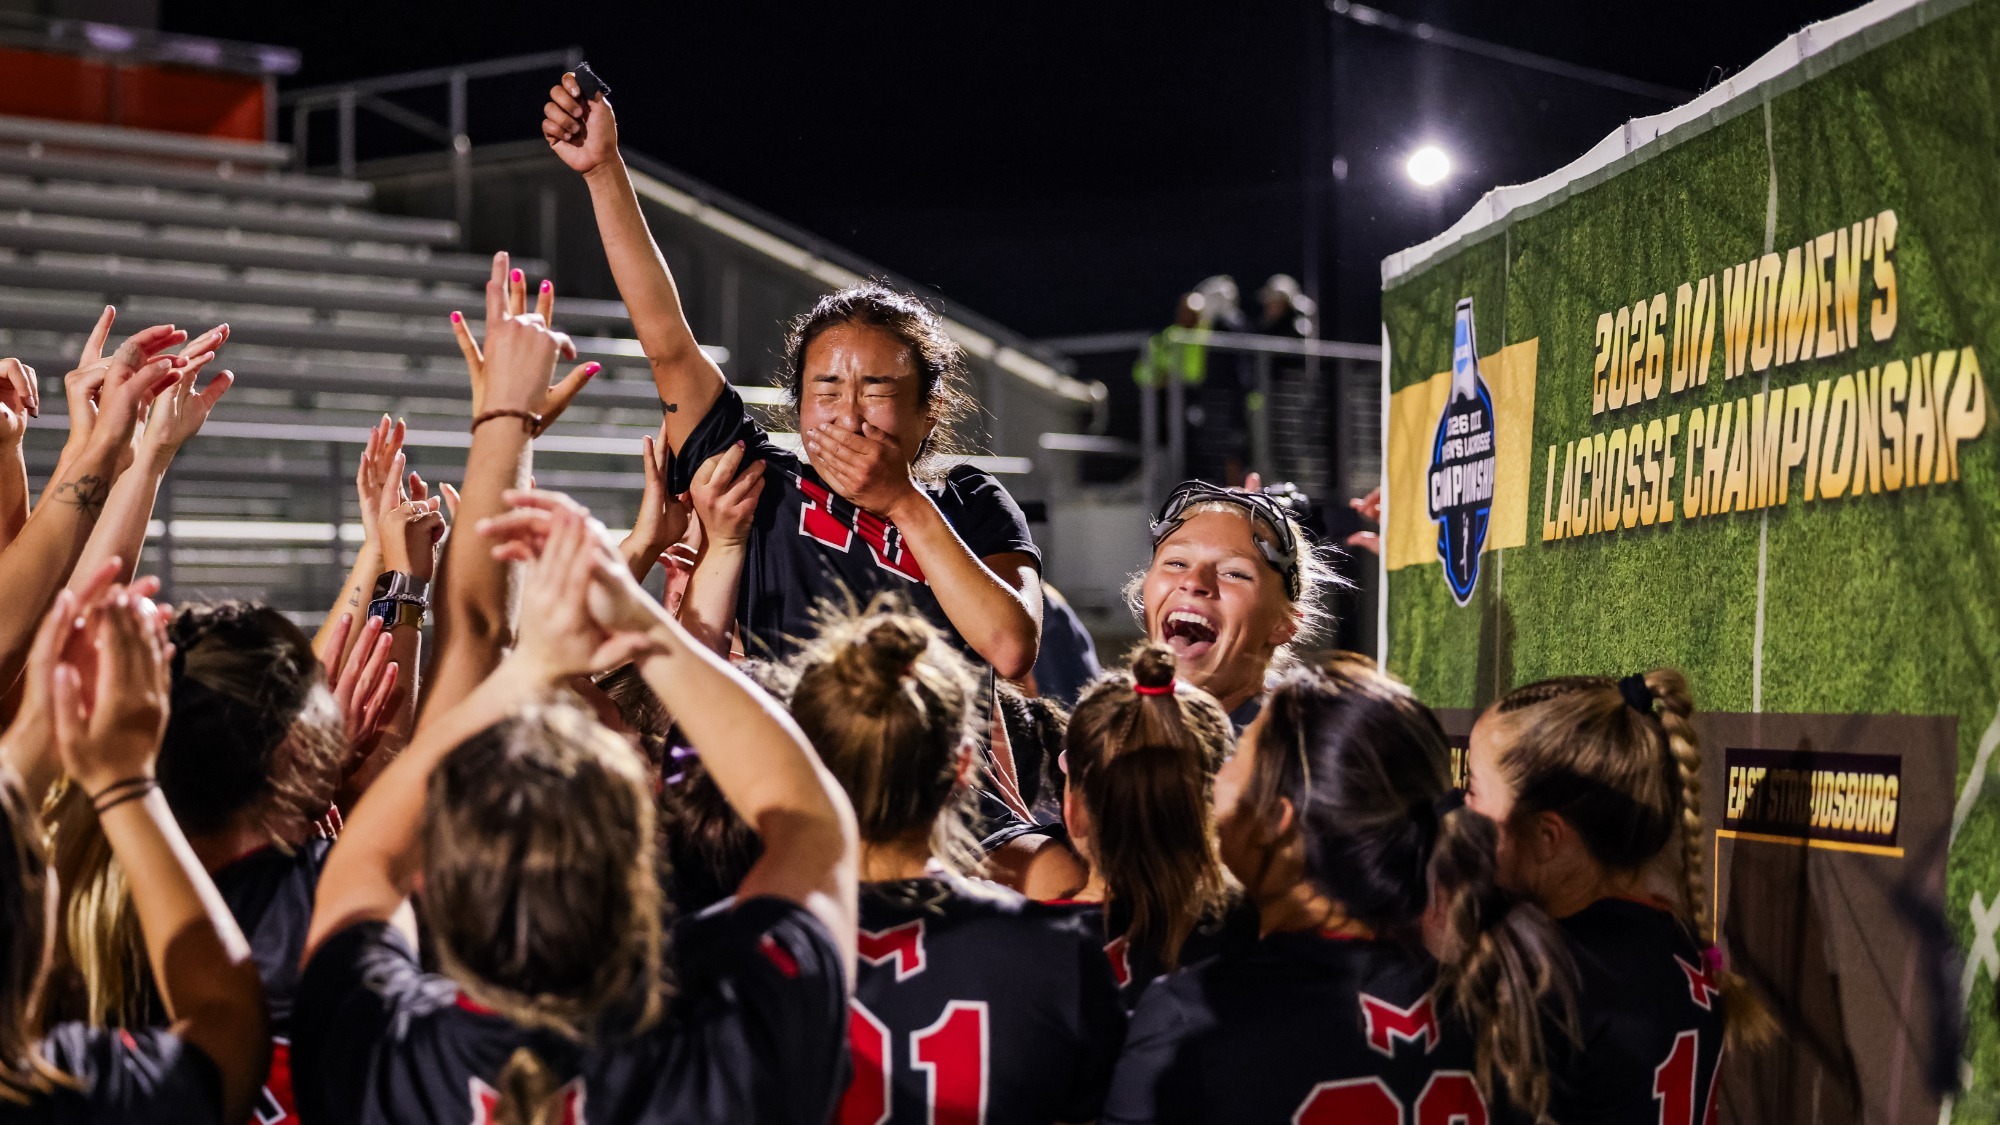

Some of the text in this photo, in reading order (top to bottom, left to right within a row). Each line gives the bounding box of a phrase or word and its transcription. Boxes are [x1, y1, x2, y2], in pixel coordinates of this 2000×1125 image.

[1593, 291, 1667, 415] 2026
[1723, 209, 1898, 380] WOMEN'S
[1543, 345, 1986, 541] LACROSSE CHAMPIONSHIP
[1727, 766, 1766, 819] EAST
